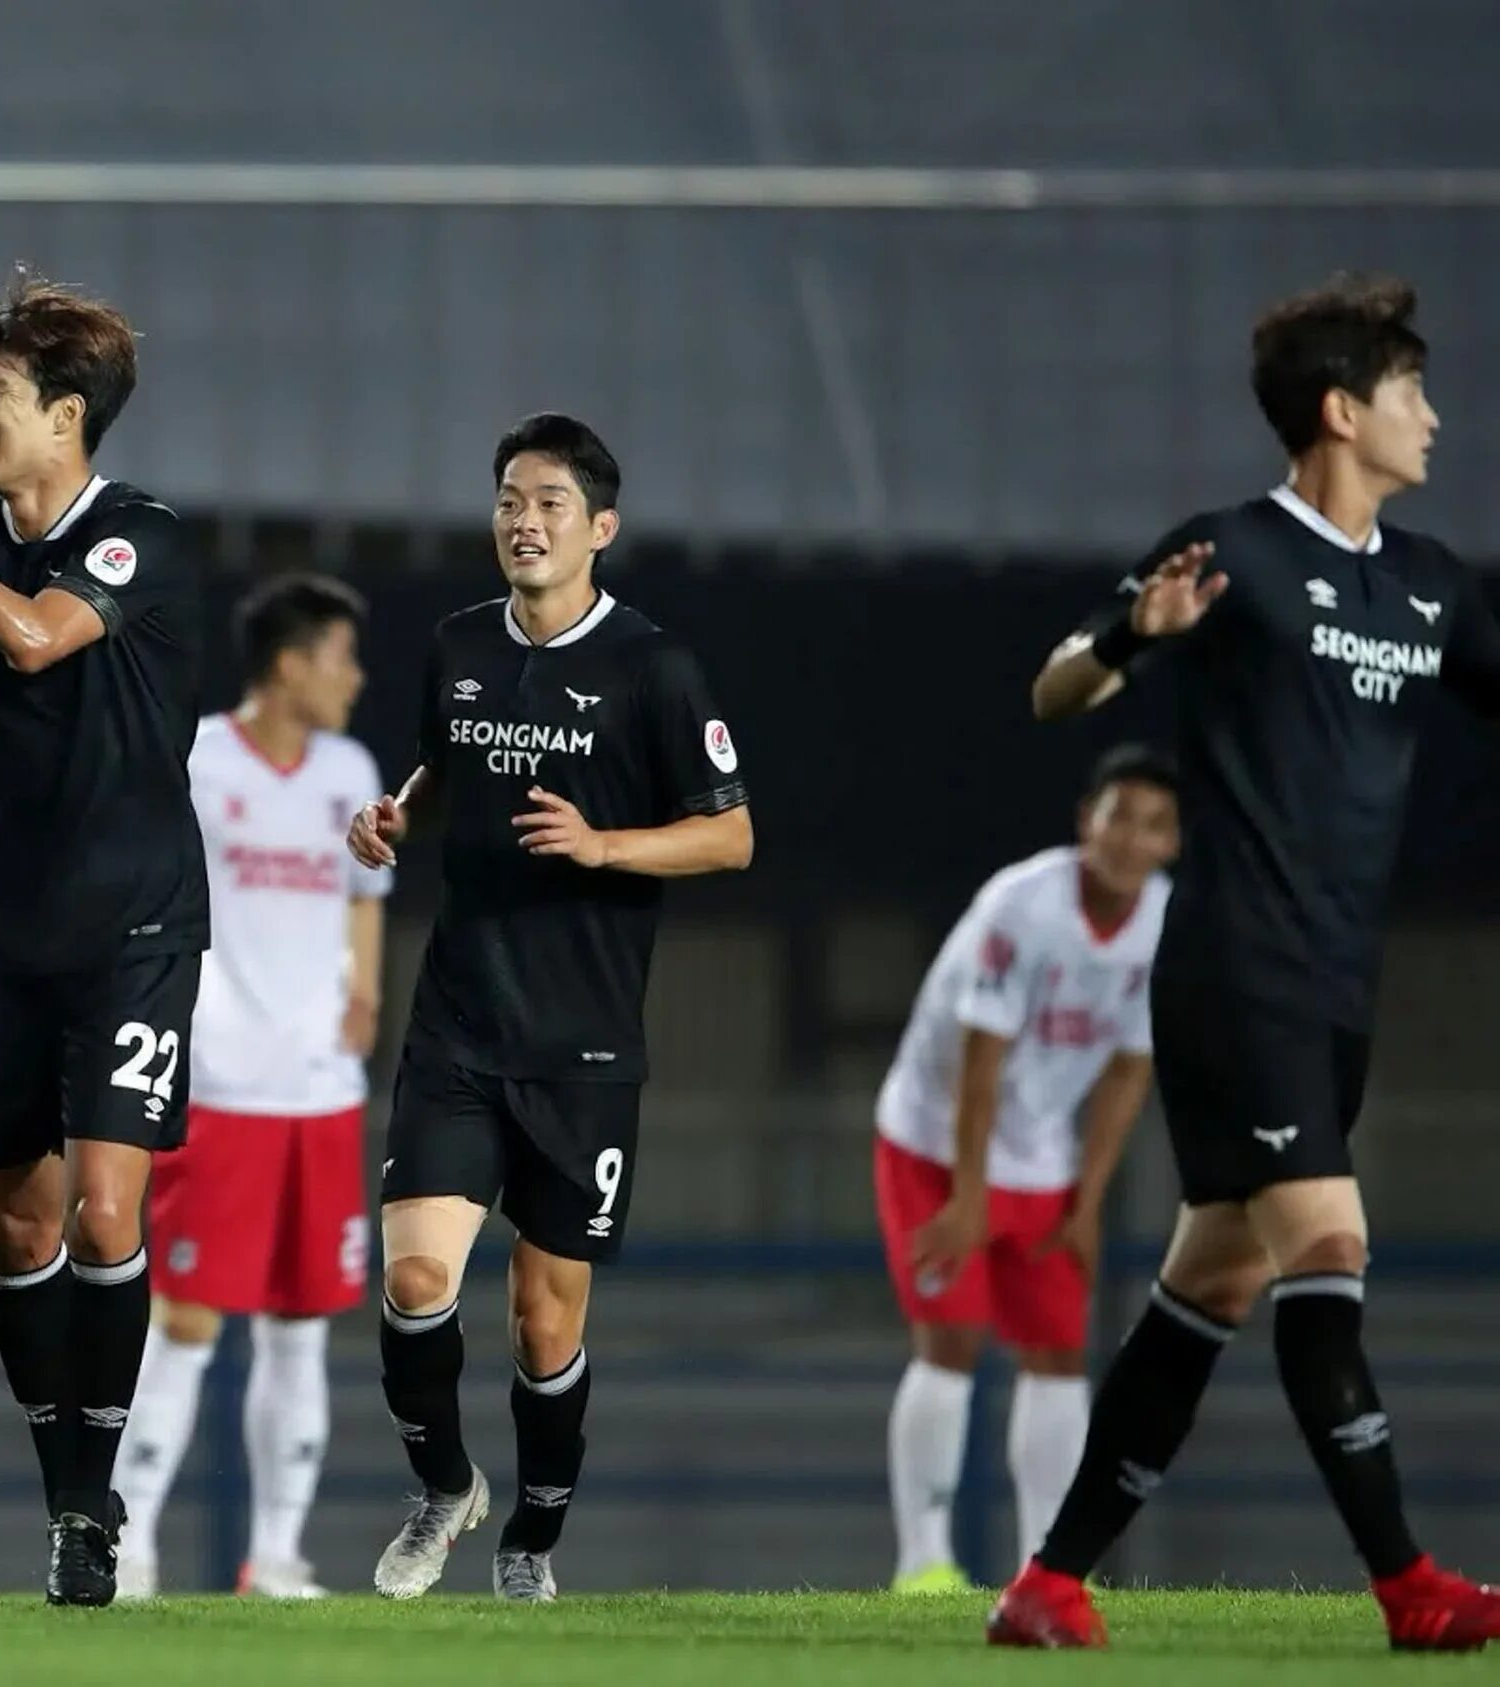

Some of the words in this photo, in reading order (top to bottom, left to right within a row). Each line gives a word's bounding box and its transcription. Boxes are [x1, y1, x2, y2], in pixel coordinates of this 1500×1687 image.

[1311, 623, 1443, 678] SEONGNAM
[1351, 665, 1405, 705] CITY
[449, 717, 594, 756] SEONGNAM
[487, 750, 542, 776] CITY
[110, 1021, 180, 1101] 22
[595, 1147, 624, 1215] 9
